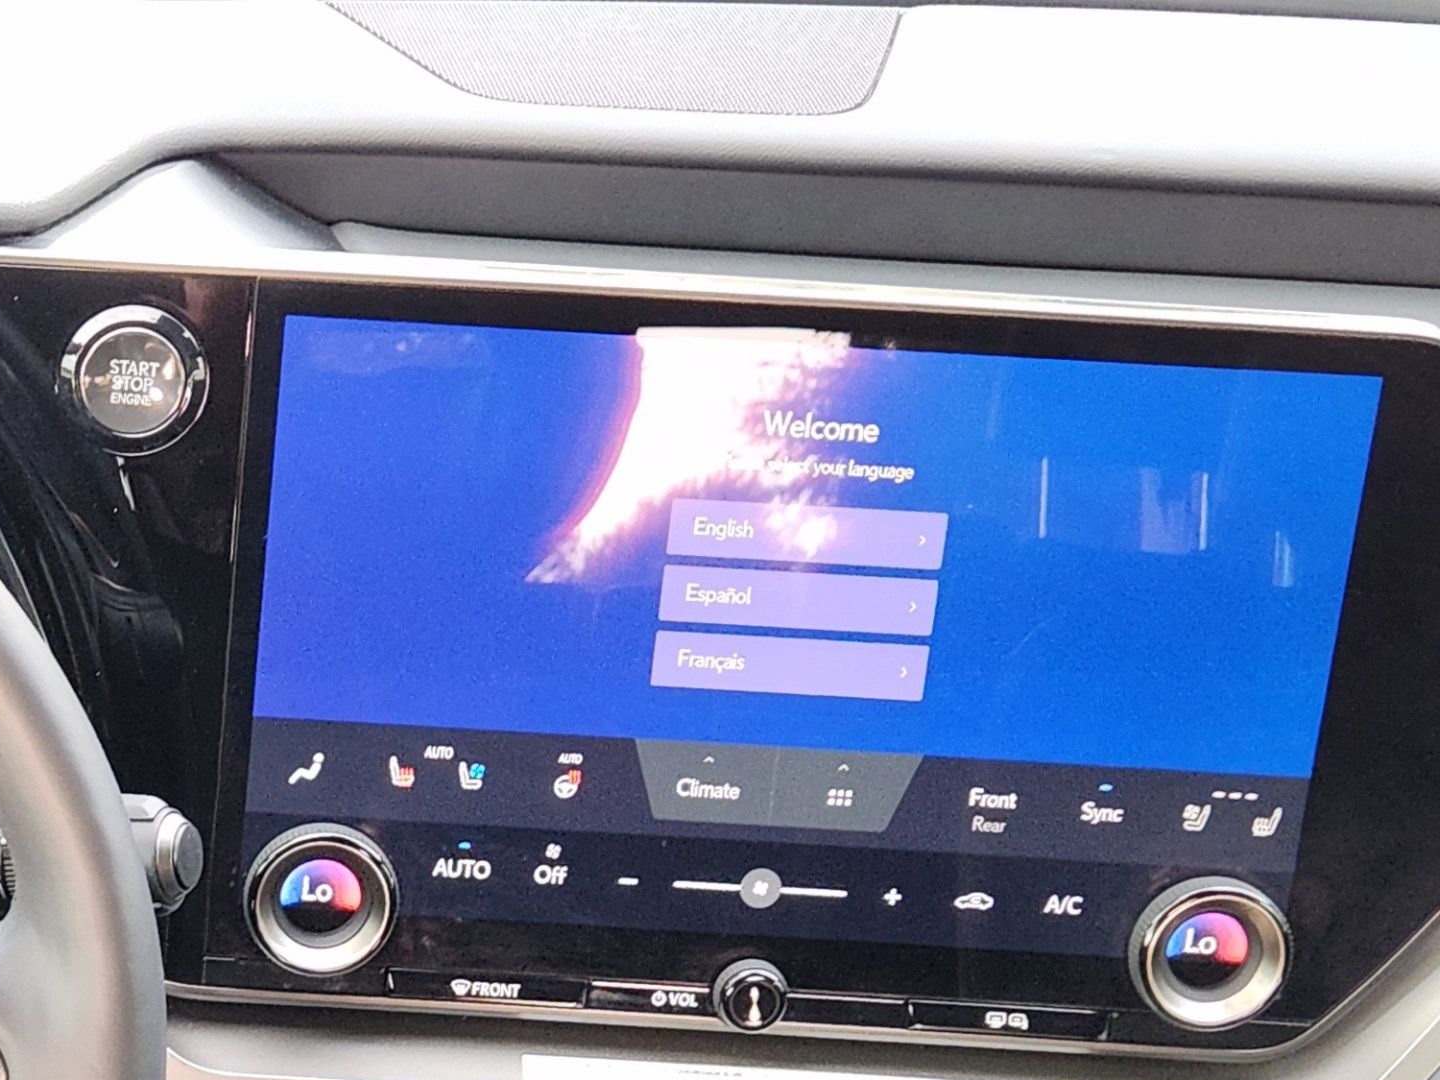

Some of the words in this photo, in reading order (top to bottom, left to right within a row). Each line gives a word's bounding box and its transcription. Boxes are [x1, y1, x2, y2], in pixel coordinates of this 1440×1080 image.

[109, 359, 160, 377] START
[111, 375, 154, 392] STOP
[110, 392, 153, 406] ENGINE
[764, 410, 880, 443] Welcome
[813, 462, 847, 478] your
[848, 458, 914, 483] language
[693, 516, 754, 541] English
[685, 583, 752, 607] Español
[677, 649, 746, 674] Français
[424, 746, 455, 760] AUTO
[558, 753, 583, 765] AUTO
[676, 777, 741, 801] Climate
[969, 787, 1018, 810] Front
[1080, 801, 1124, 824] Sync
[971, 815, 1006, 834] Rear
[432, 857, 491, 880] AUTO
[534, 865, 568, 885] Off
[301, 875, 333, 903] Lo
[1043, 894, 1084, 916] A/C
[1183, 927, 1217, 955] Lo
[472, 981, 521, 999] FRONT
[669, 991, 698, 1008] VOL
